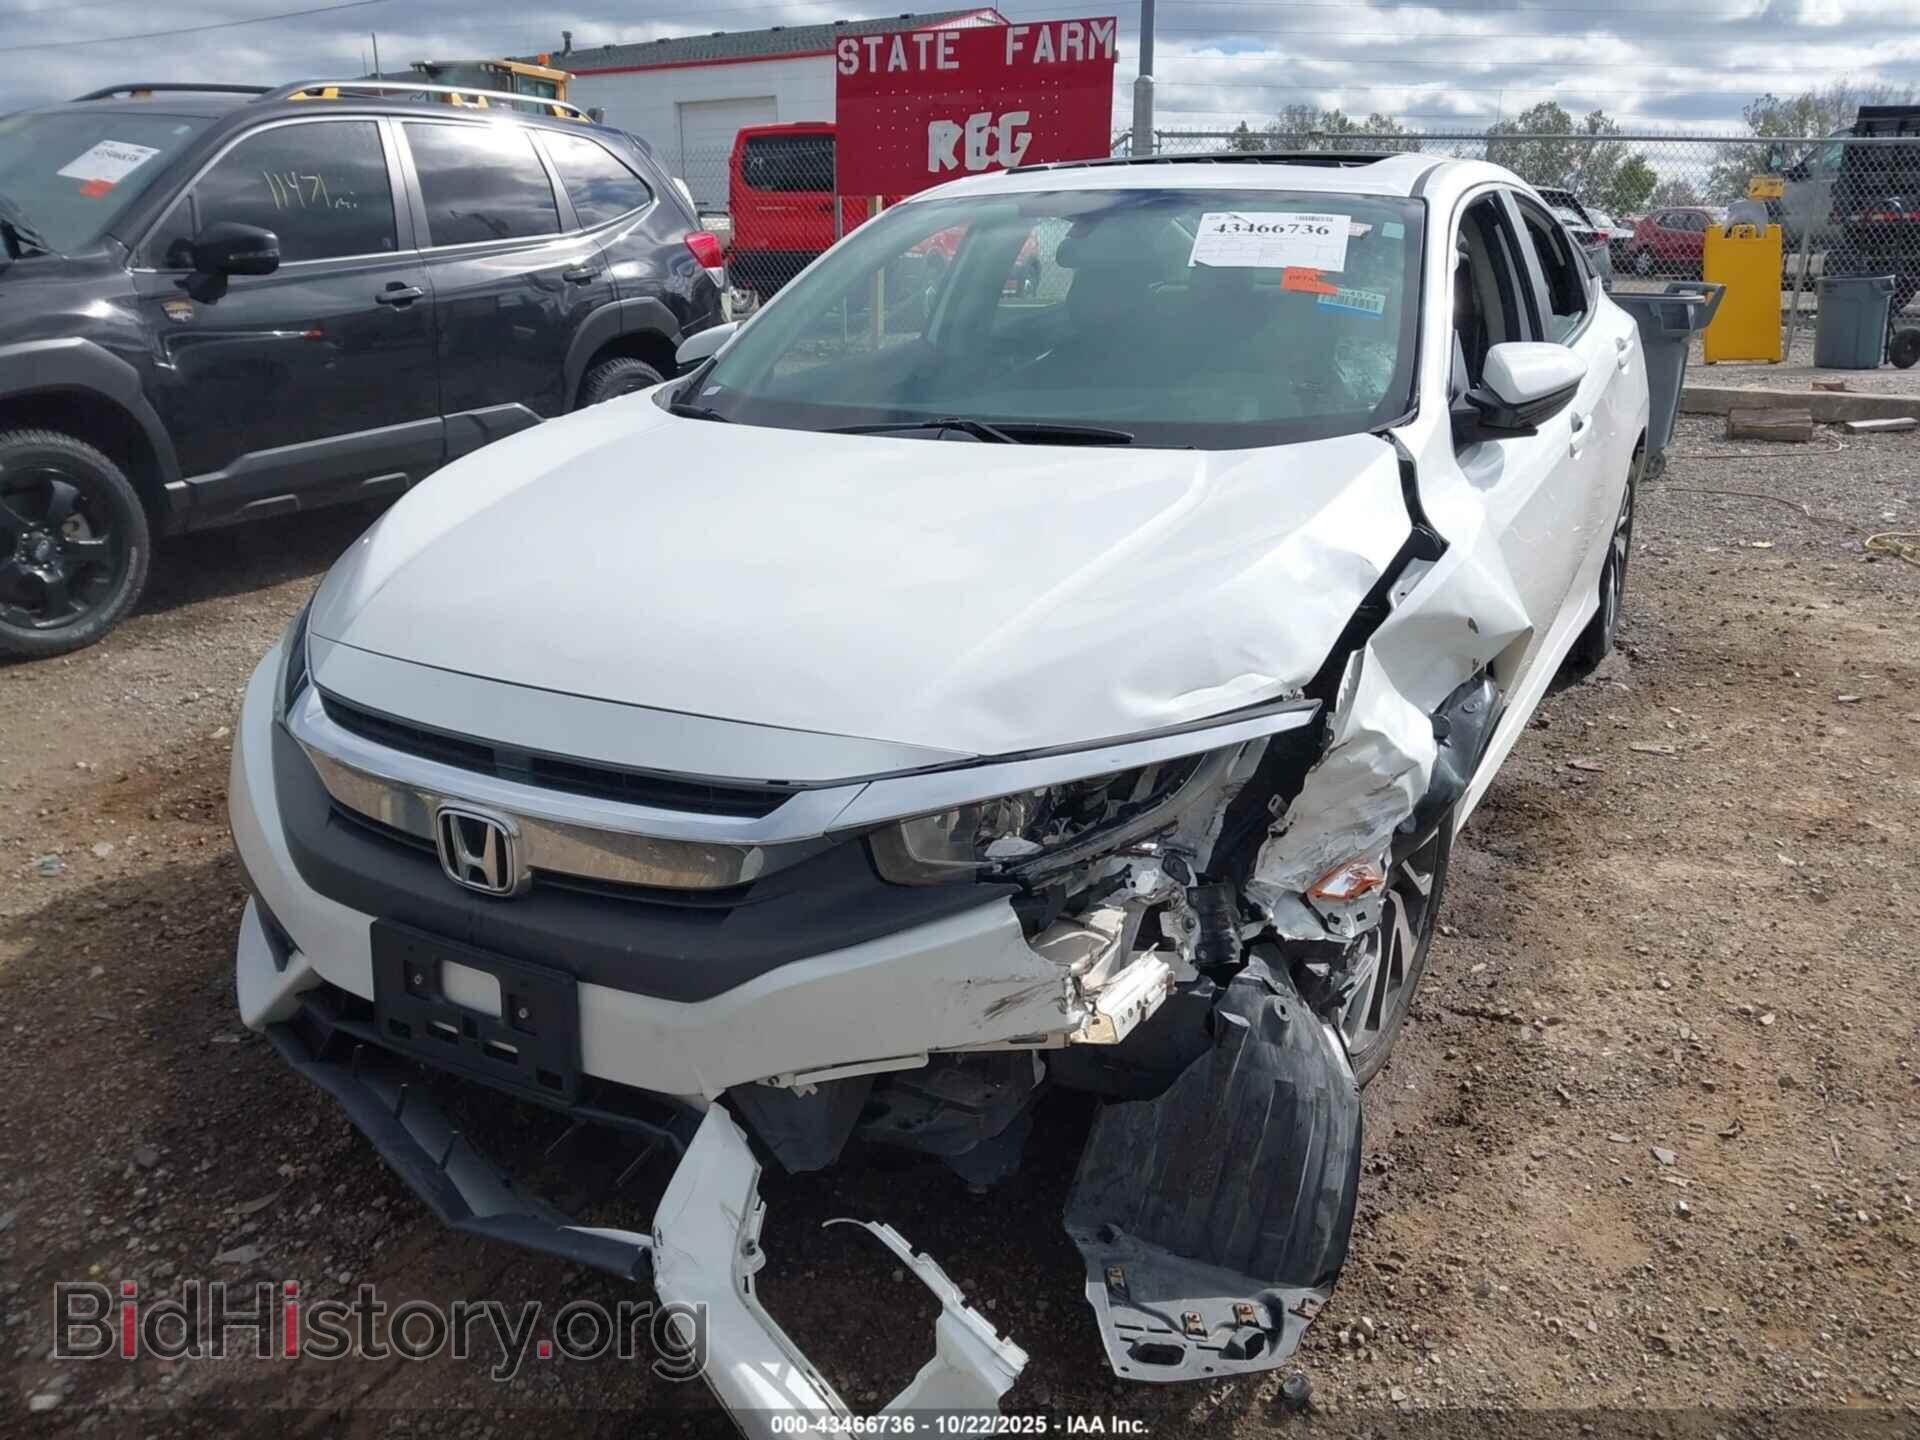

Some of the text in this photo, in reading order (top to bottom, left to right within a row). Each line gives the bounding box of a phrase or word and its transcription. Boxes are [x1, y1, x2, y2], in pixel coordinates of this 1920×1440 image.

[837, 19, 1115, 75] STATE FARM
[263, 170, 331, 209] 11471
[1213, 222, 1330, 236] 43466736
